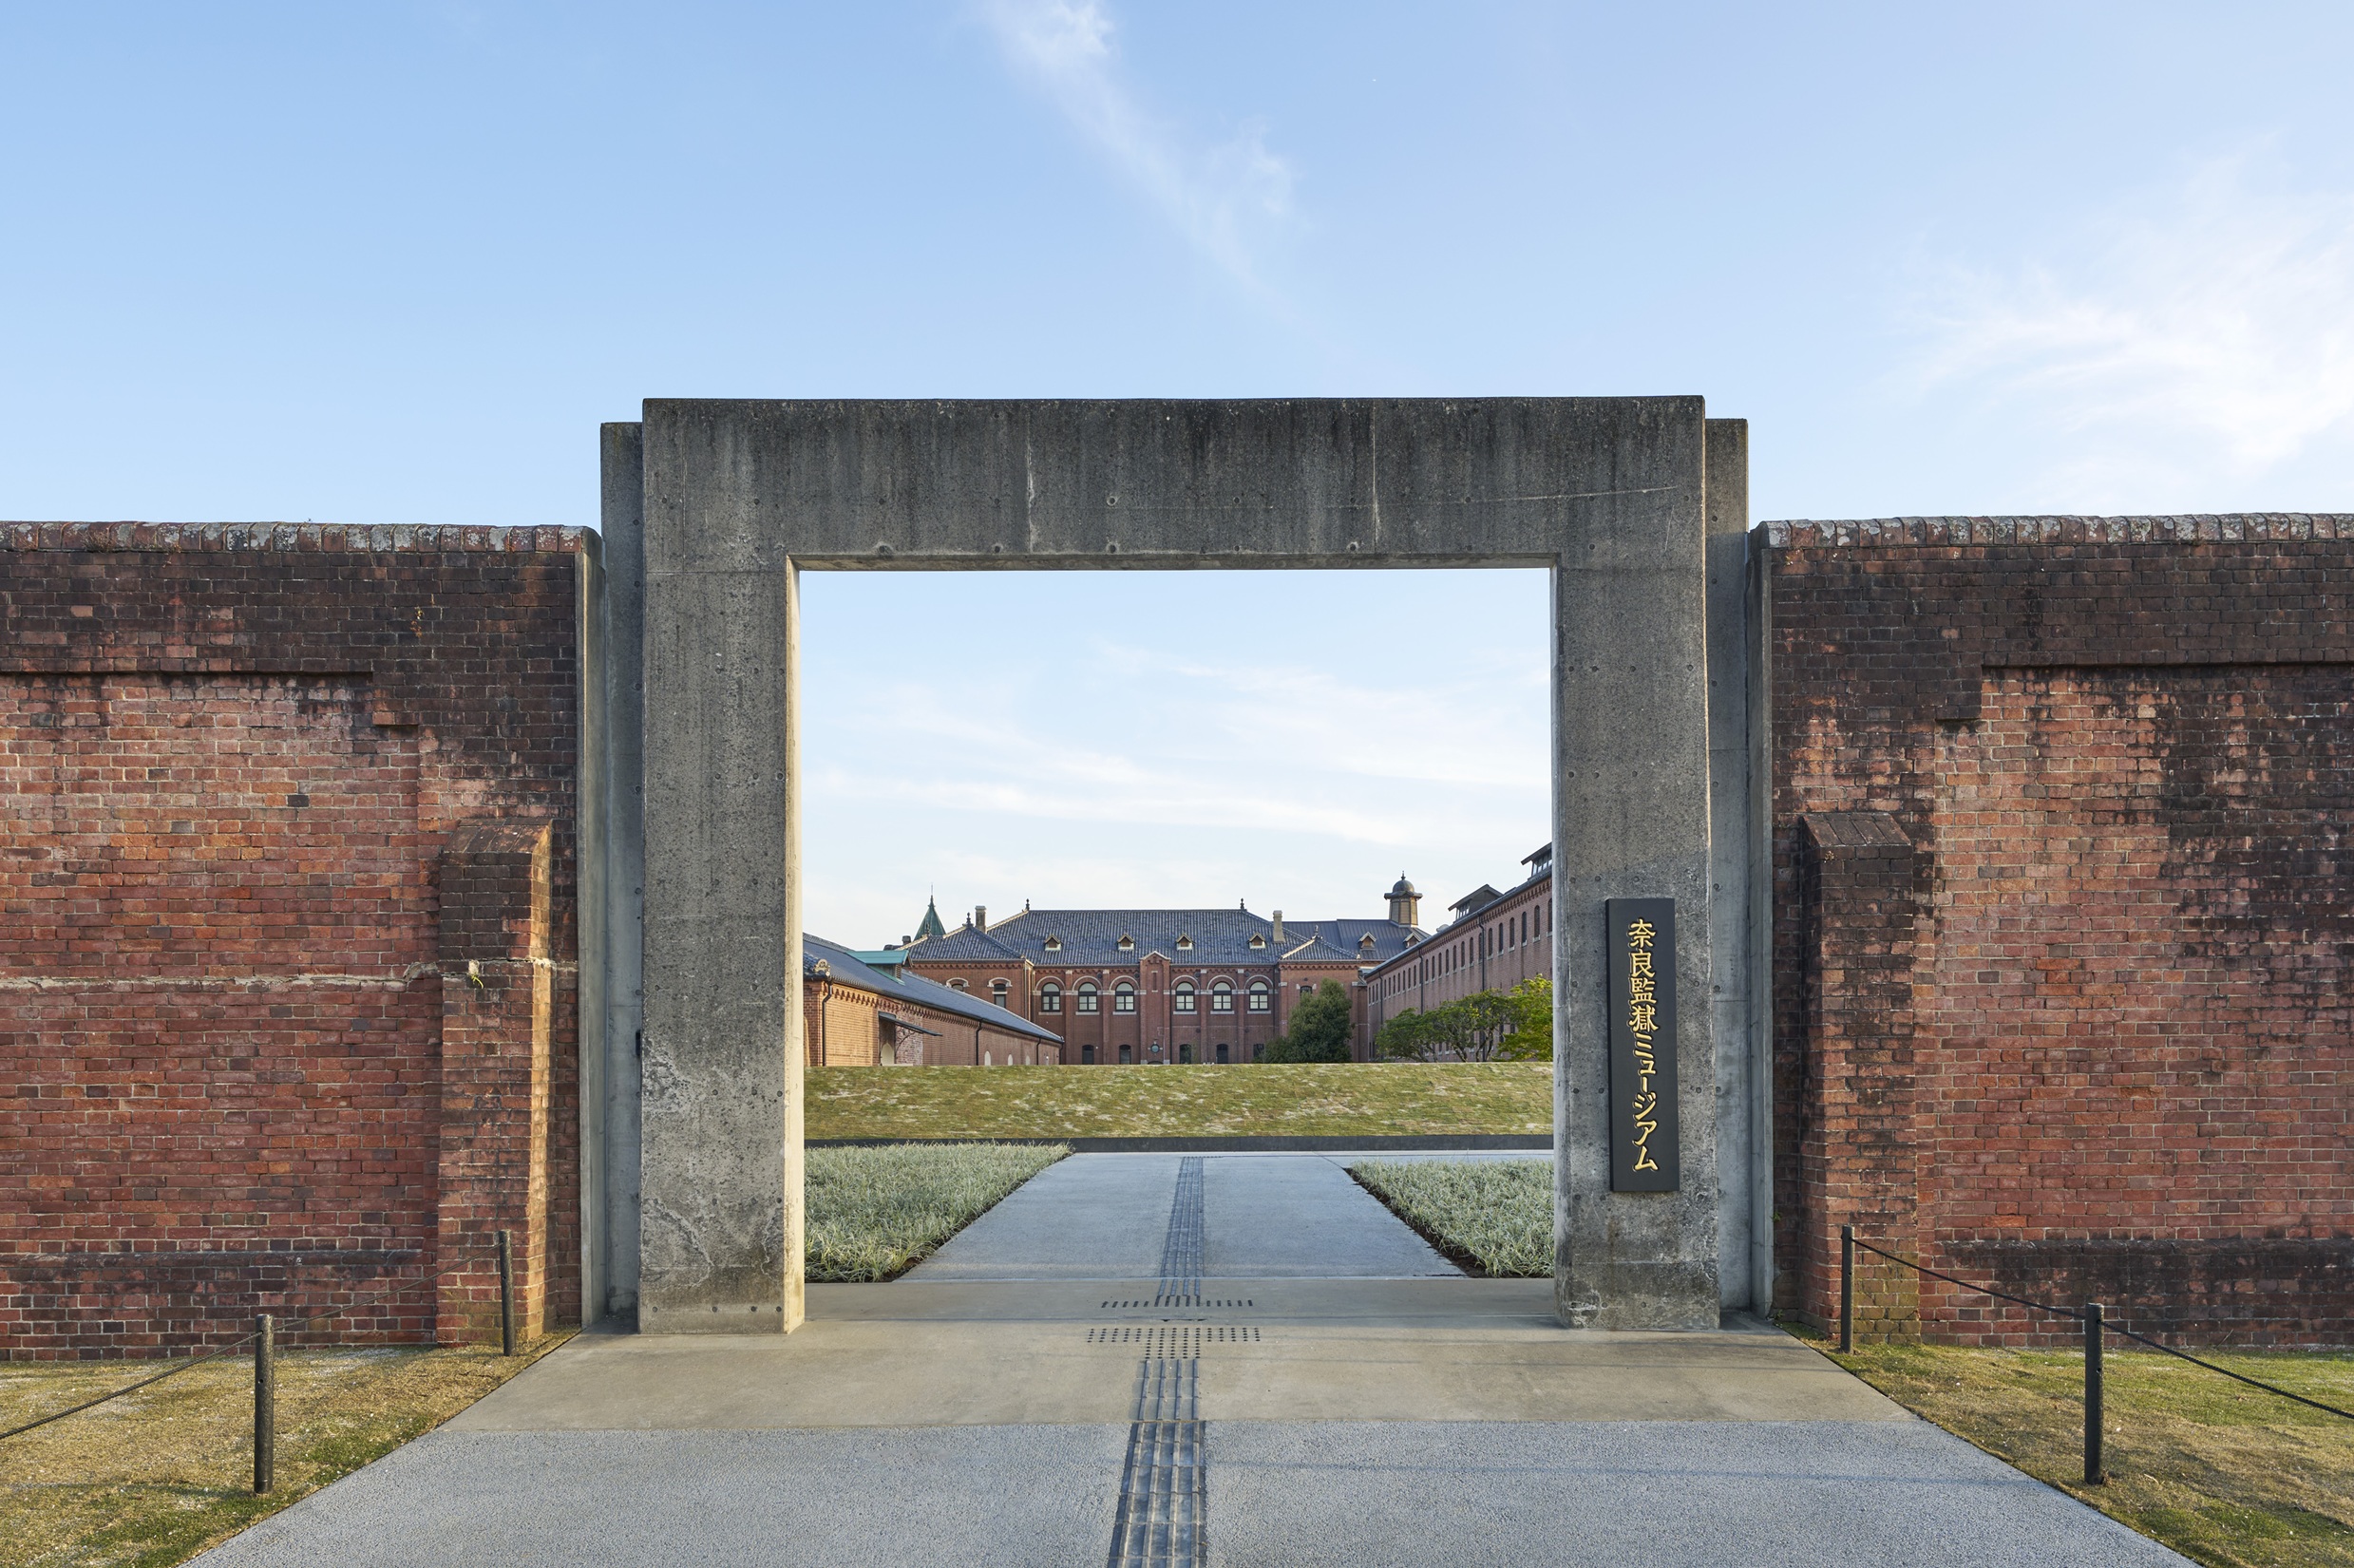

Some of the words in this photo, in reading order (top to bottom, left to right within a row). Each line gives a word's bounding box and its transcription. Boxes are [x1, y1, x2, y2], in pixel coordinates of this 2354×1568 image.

[1628, 918, 1659, 1172] 奈良監獄ミュージアム
